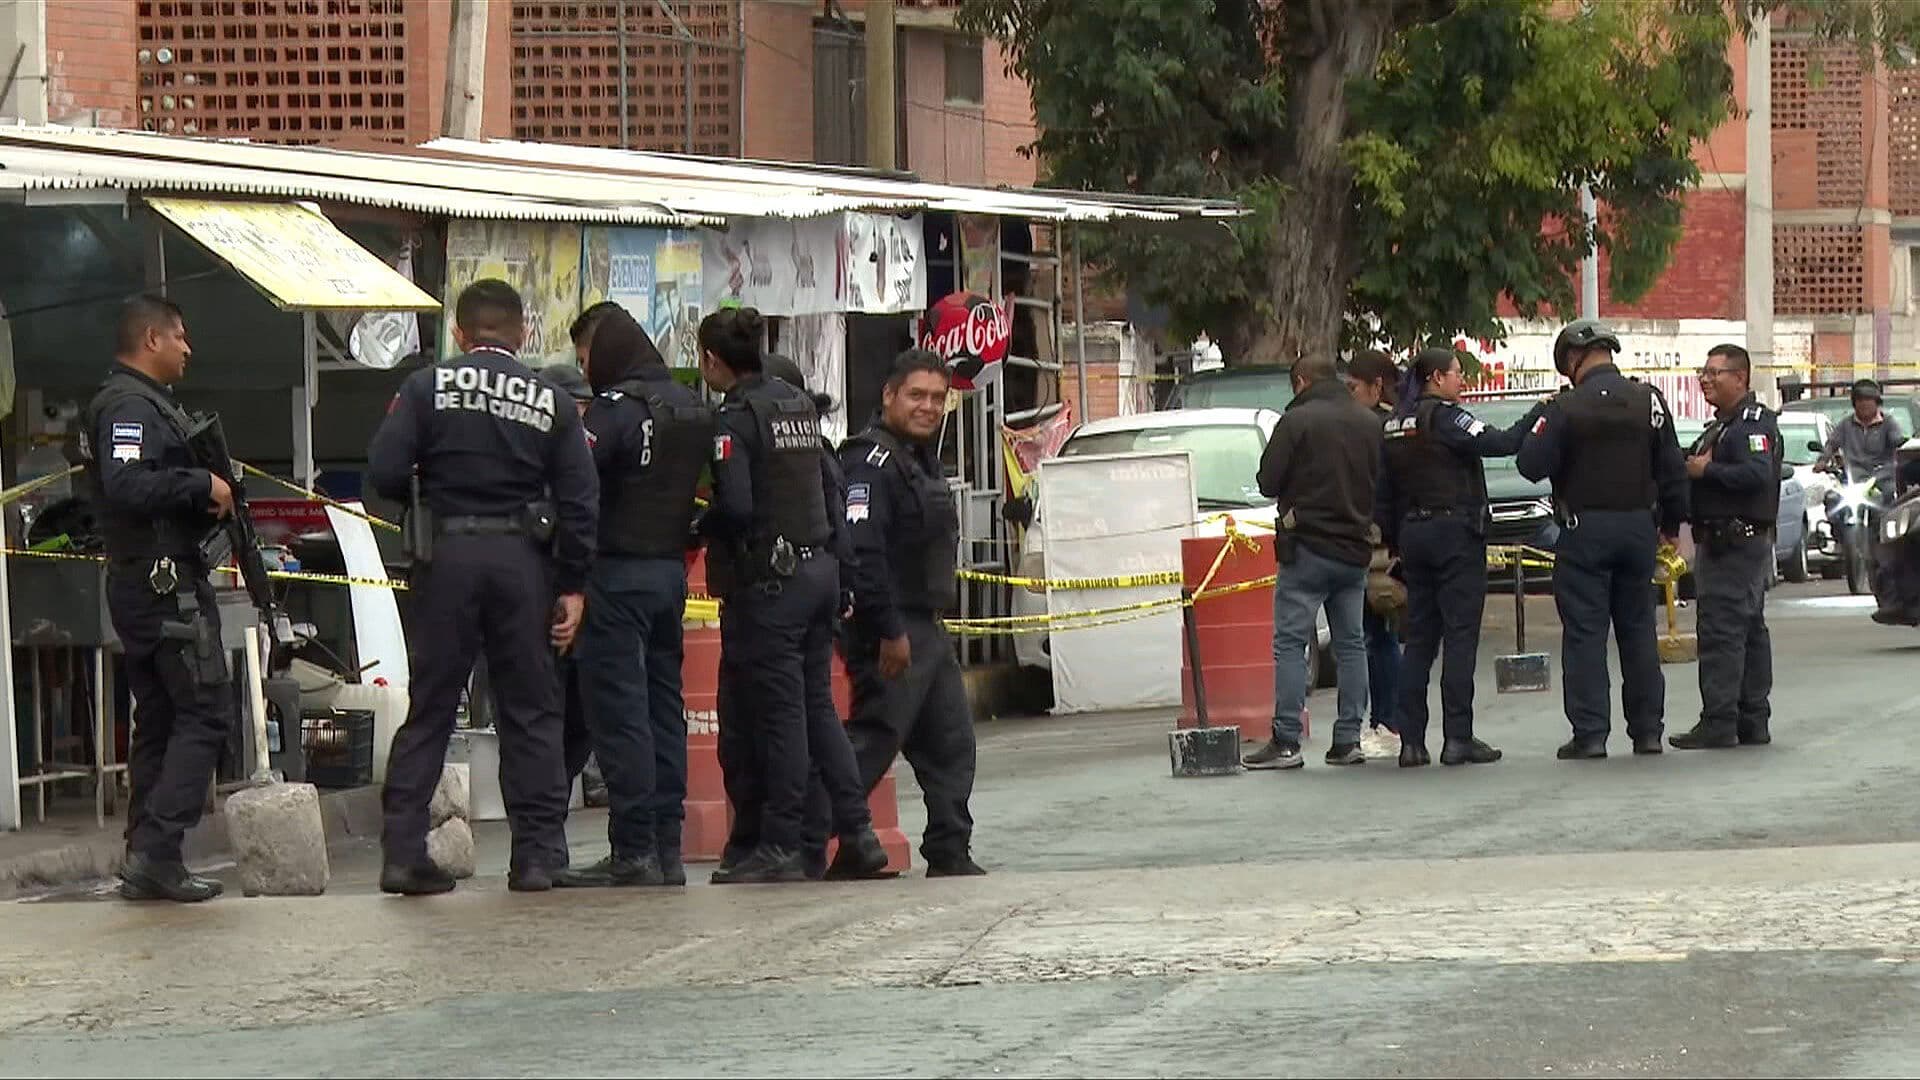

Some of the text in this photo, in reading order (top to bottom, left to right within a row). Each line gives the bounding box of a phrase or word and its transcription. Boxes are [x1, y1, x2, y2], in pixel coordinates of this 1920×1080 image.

[434, 391, 553, 432] DE LA CIUDAD
[435, 367, 556, 416] POLICÍA
